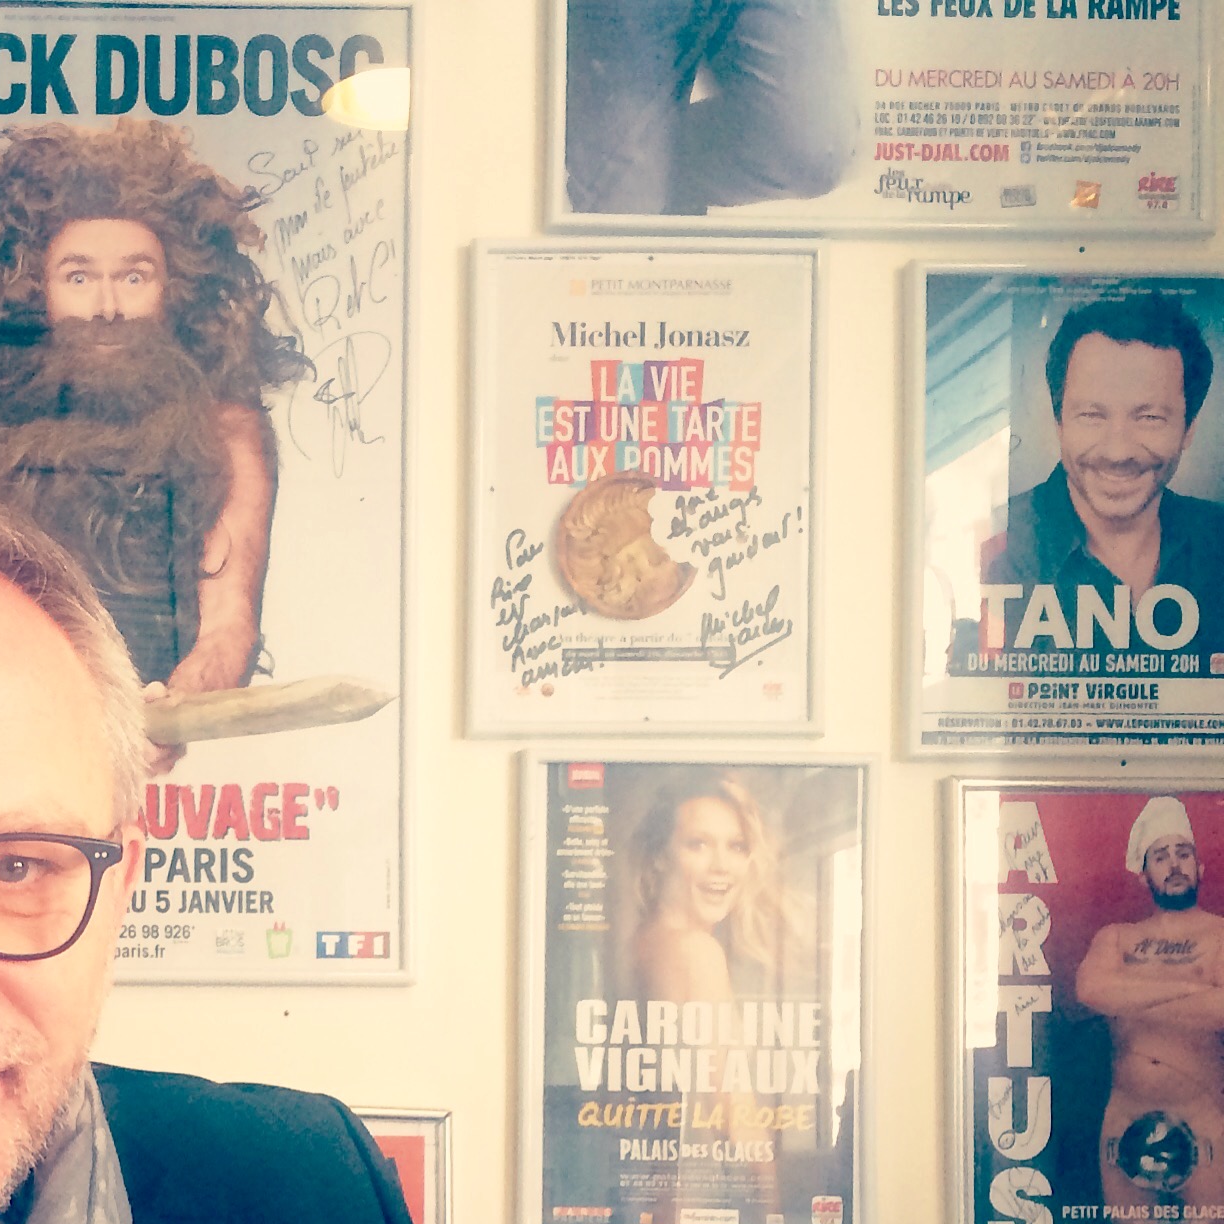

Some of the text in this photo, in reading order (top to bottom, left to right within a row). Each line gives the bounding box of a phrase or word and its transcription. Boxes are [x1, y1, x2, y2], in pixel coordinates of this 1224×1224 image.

[877, 0, 1181, 21] LES FEUX DE LA RAMPE
[874, 68, 902, 88] DU
[907, 69, 1003, 89] MERCREDI
[1008, 72, 1036, 90] AU
[1042, 71, 1115, 91] SAMEDI
[1142, 71, 1180, 92] 20H
[874, 142, 1010, 163] JUST-DJAL.COM
[550, 320, 751, 350] Michel Jonasz
[600, 365, 698, 403] LA VIE
[537, 405, 759, 443] EST UNE TARTE
[549, 445, 755, 485] AUX POMMES
[976, 582, 1200, 651] TANO
[967, 652, 1200, 673] DU MERCREDI AU SAMEDI 20H
[1027, 682, 1160, 701] POINT VIRGULE
[143, 847, 256, 884] PARIS
[126, 889, 275, 915] U 5 JANVIER
[141, 924, 160, 940] 98
[320, 934, 386, 957] TF1
[575, 998, 822, 1048] CAROLINE
[574, 1046, 821, 1095] VIGNEAUX
[691, 1102, 725, 1129] LA
[731, 1104, 816, 1131] ROBE
[619, 1137, 774, 1162] PALAIS DES GLACES
[1061, 1205, 1099, 1219] PETIT
[1102, 1205, 1150, 1219] PALAIS
[1153, 1205, 1180, 1219] DES
